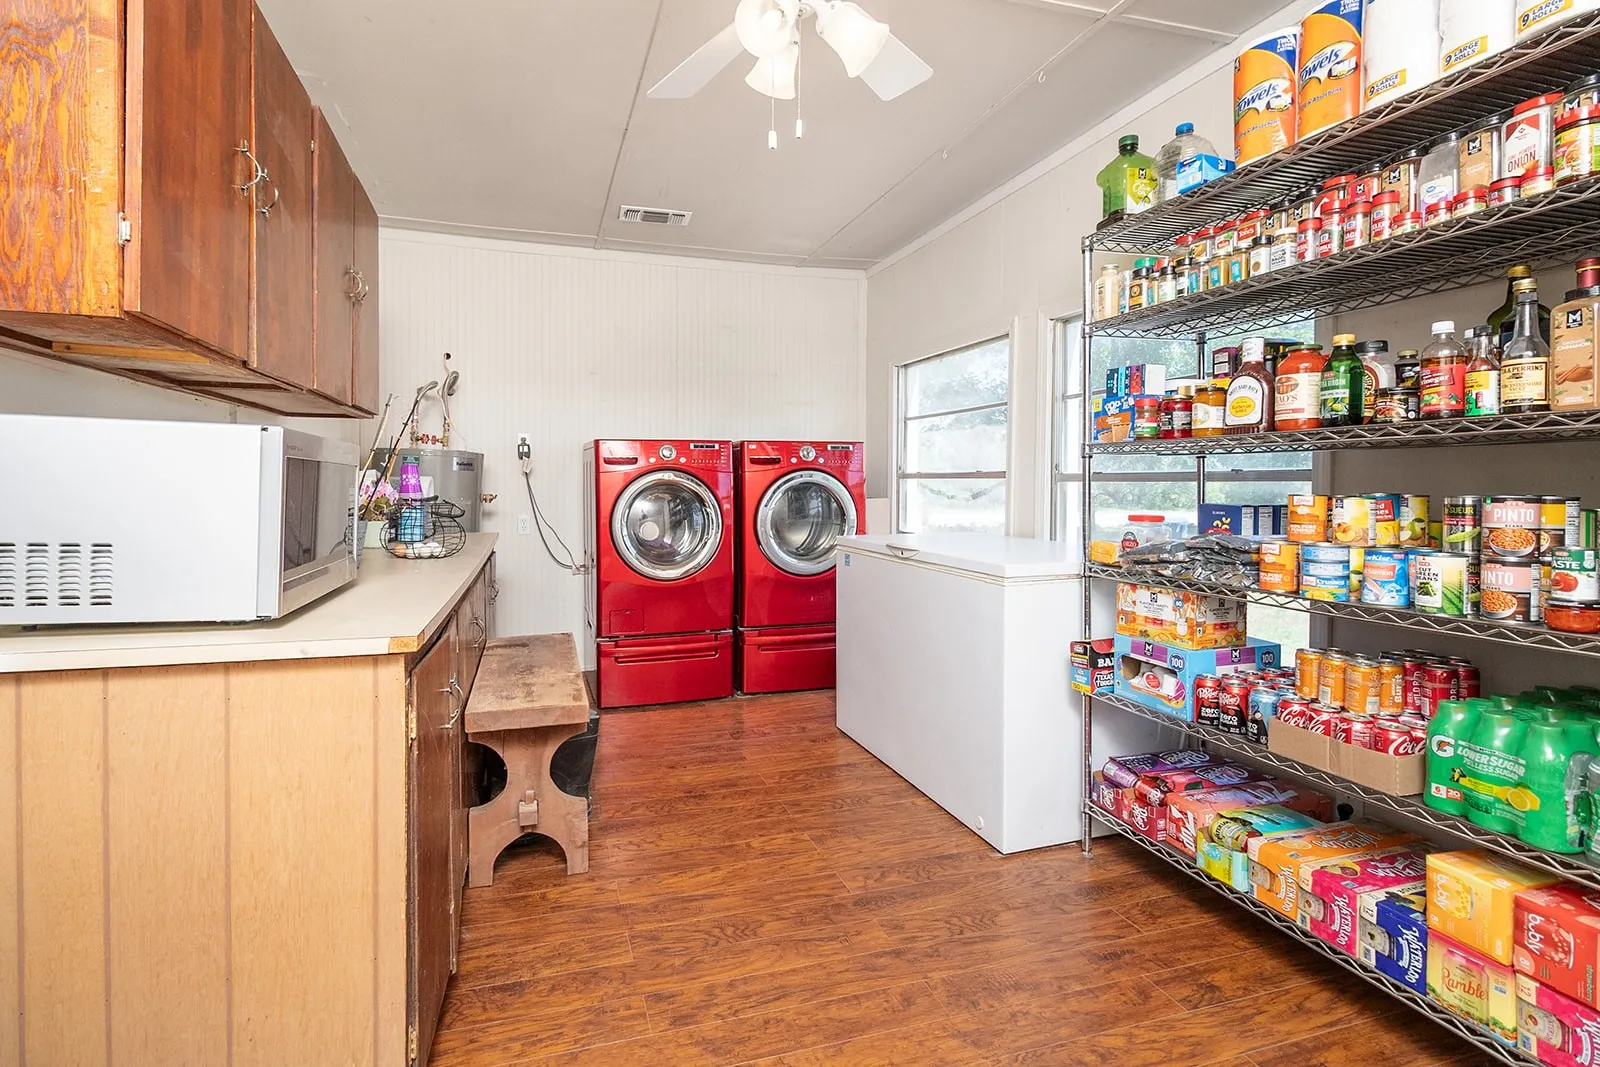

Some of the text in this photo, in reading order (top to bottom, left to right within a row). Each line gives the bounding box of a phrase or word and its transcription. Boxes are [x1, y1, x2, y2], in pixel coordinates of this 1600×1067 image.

[1521, 13, 1530, 27] 9
[1532, 5, 1559, 22] ROLLS
[1444, 40, 1479, 66] 9 LARGE
[1454, 49, 1476, 63] ROLLS
[1369, 73, 1399, 96] 9 LARGE
[1376, 80, 1397, 92] ROLLS
[1507, 150, 1536, 173] ONION
[1511, 364, 1544, 373] PERRINS
[1494, 508, 1534, 522] PINTO
[1170, 658, 1184, 668] 100
[1262, 655, 1274, 663] 100
[1431, 735, 1455, 757] G
[1457, 746, 1526, 776] LOWER SUGAR
[1475, 761, 1494, 772] LESS
[1494, 765, 1519, 780] SUGAR
[1447, 788, 1460, 797] 20
[1278, 863, 1298, 912] WATERLOO
[1331, 893, 1355, 946] WATERLOO
[1366, 906, 1374, 917] 12
[1528, 913, 1545, 954] bubly
[1399, 924, 1427, 985] WATERLOO
[1519, 983, 1532, 997] 12
